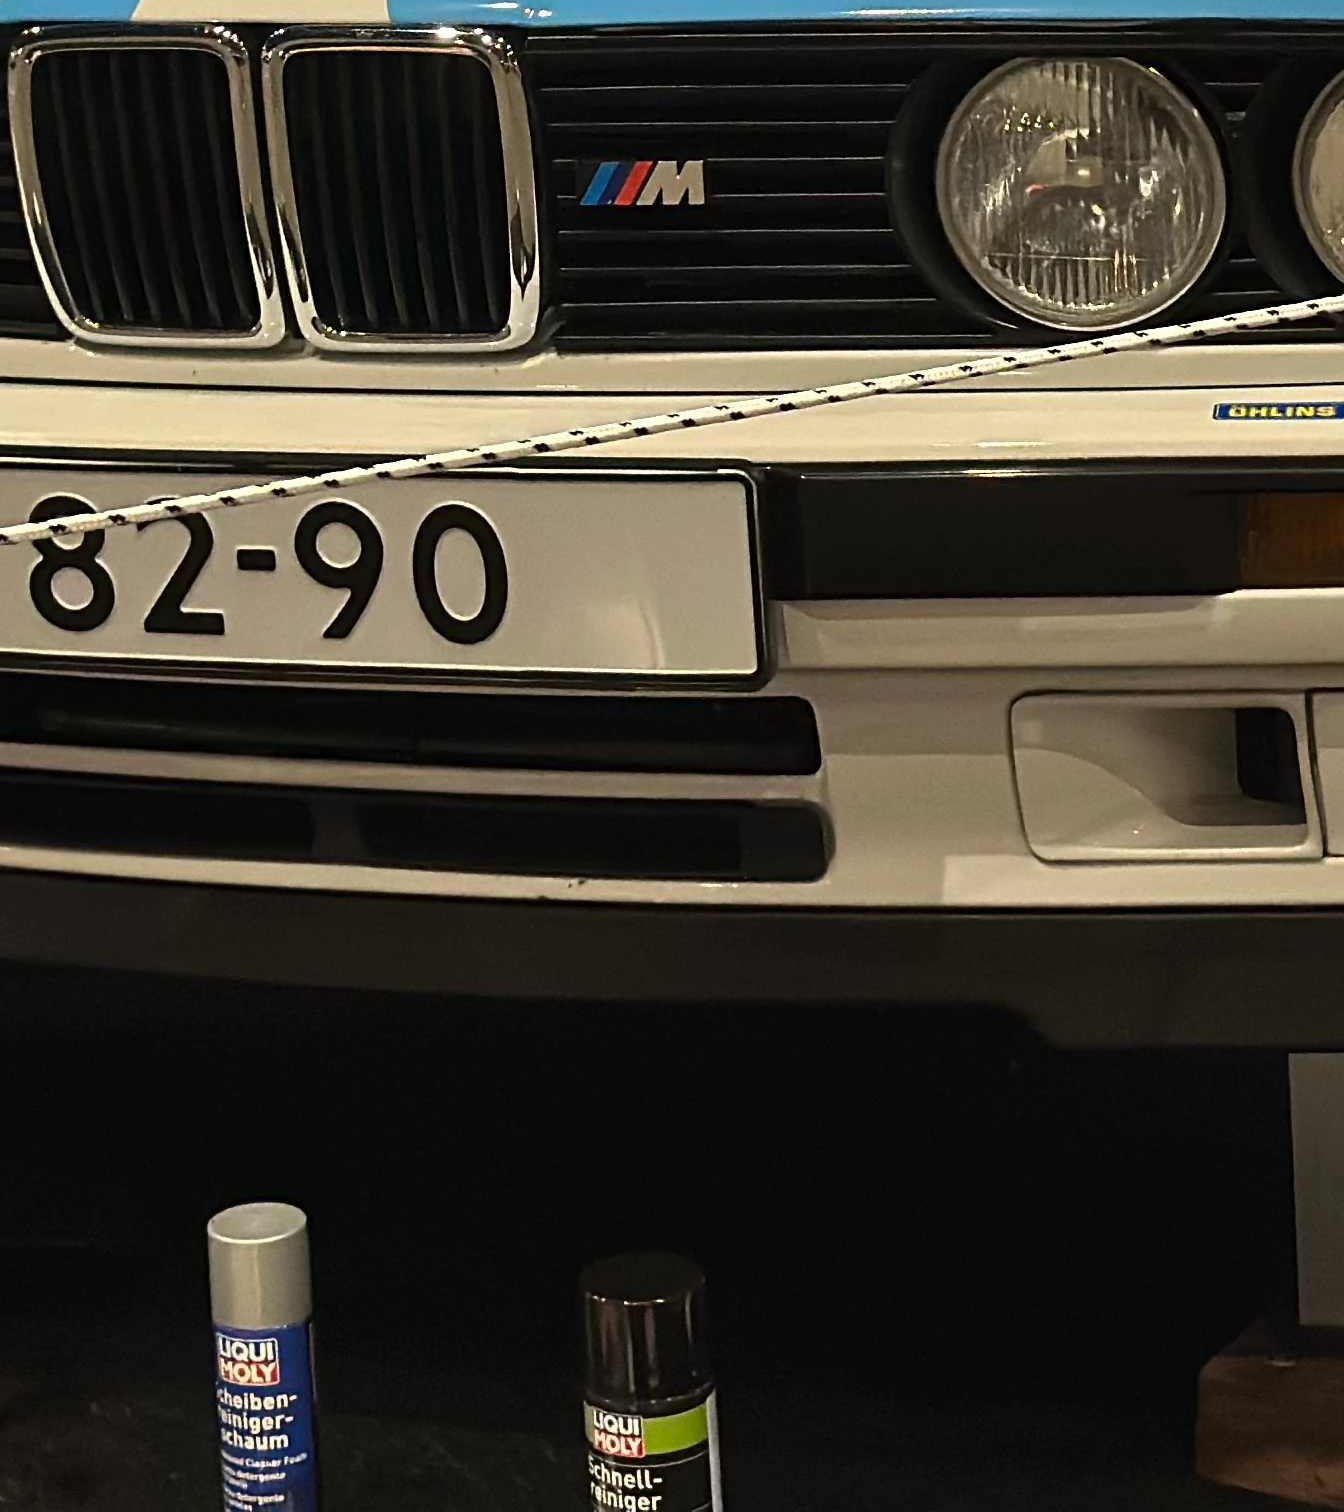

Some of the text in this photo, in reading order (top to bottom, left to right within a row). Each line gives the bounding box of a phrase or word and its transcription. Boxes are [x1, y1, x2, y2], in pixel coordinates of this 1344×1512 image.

[1228, 404, 1337, 418] ÖHLINS
[26, 492, 511, 647] 82-90
[219, 1337, 275, 1362] LIQUI
[221, 1360, 277, 1384] MOLY
[593, 1409, 641, 1436] LIQUI
[594, 1429, 643, 1458] MOLY
